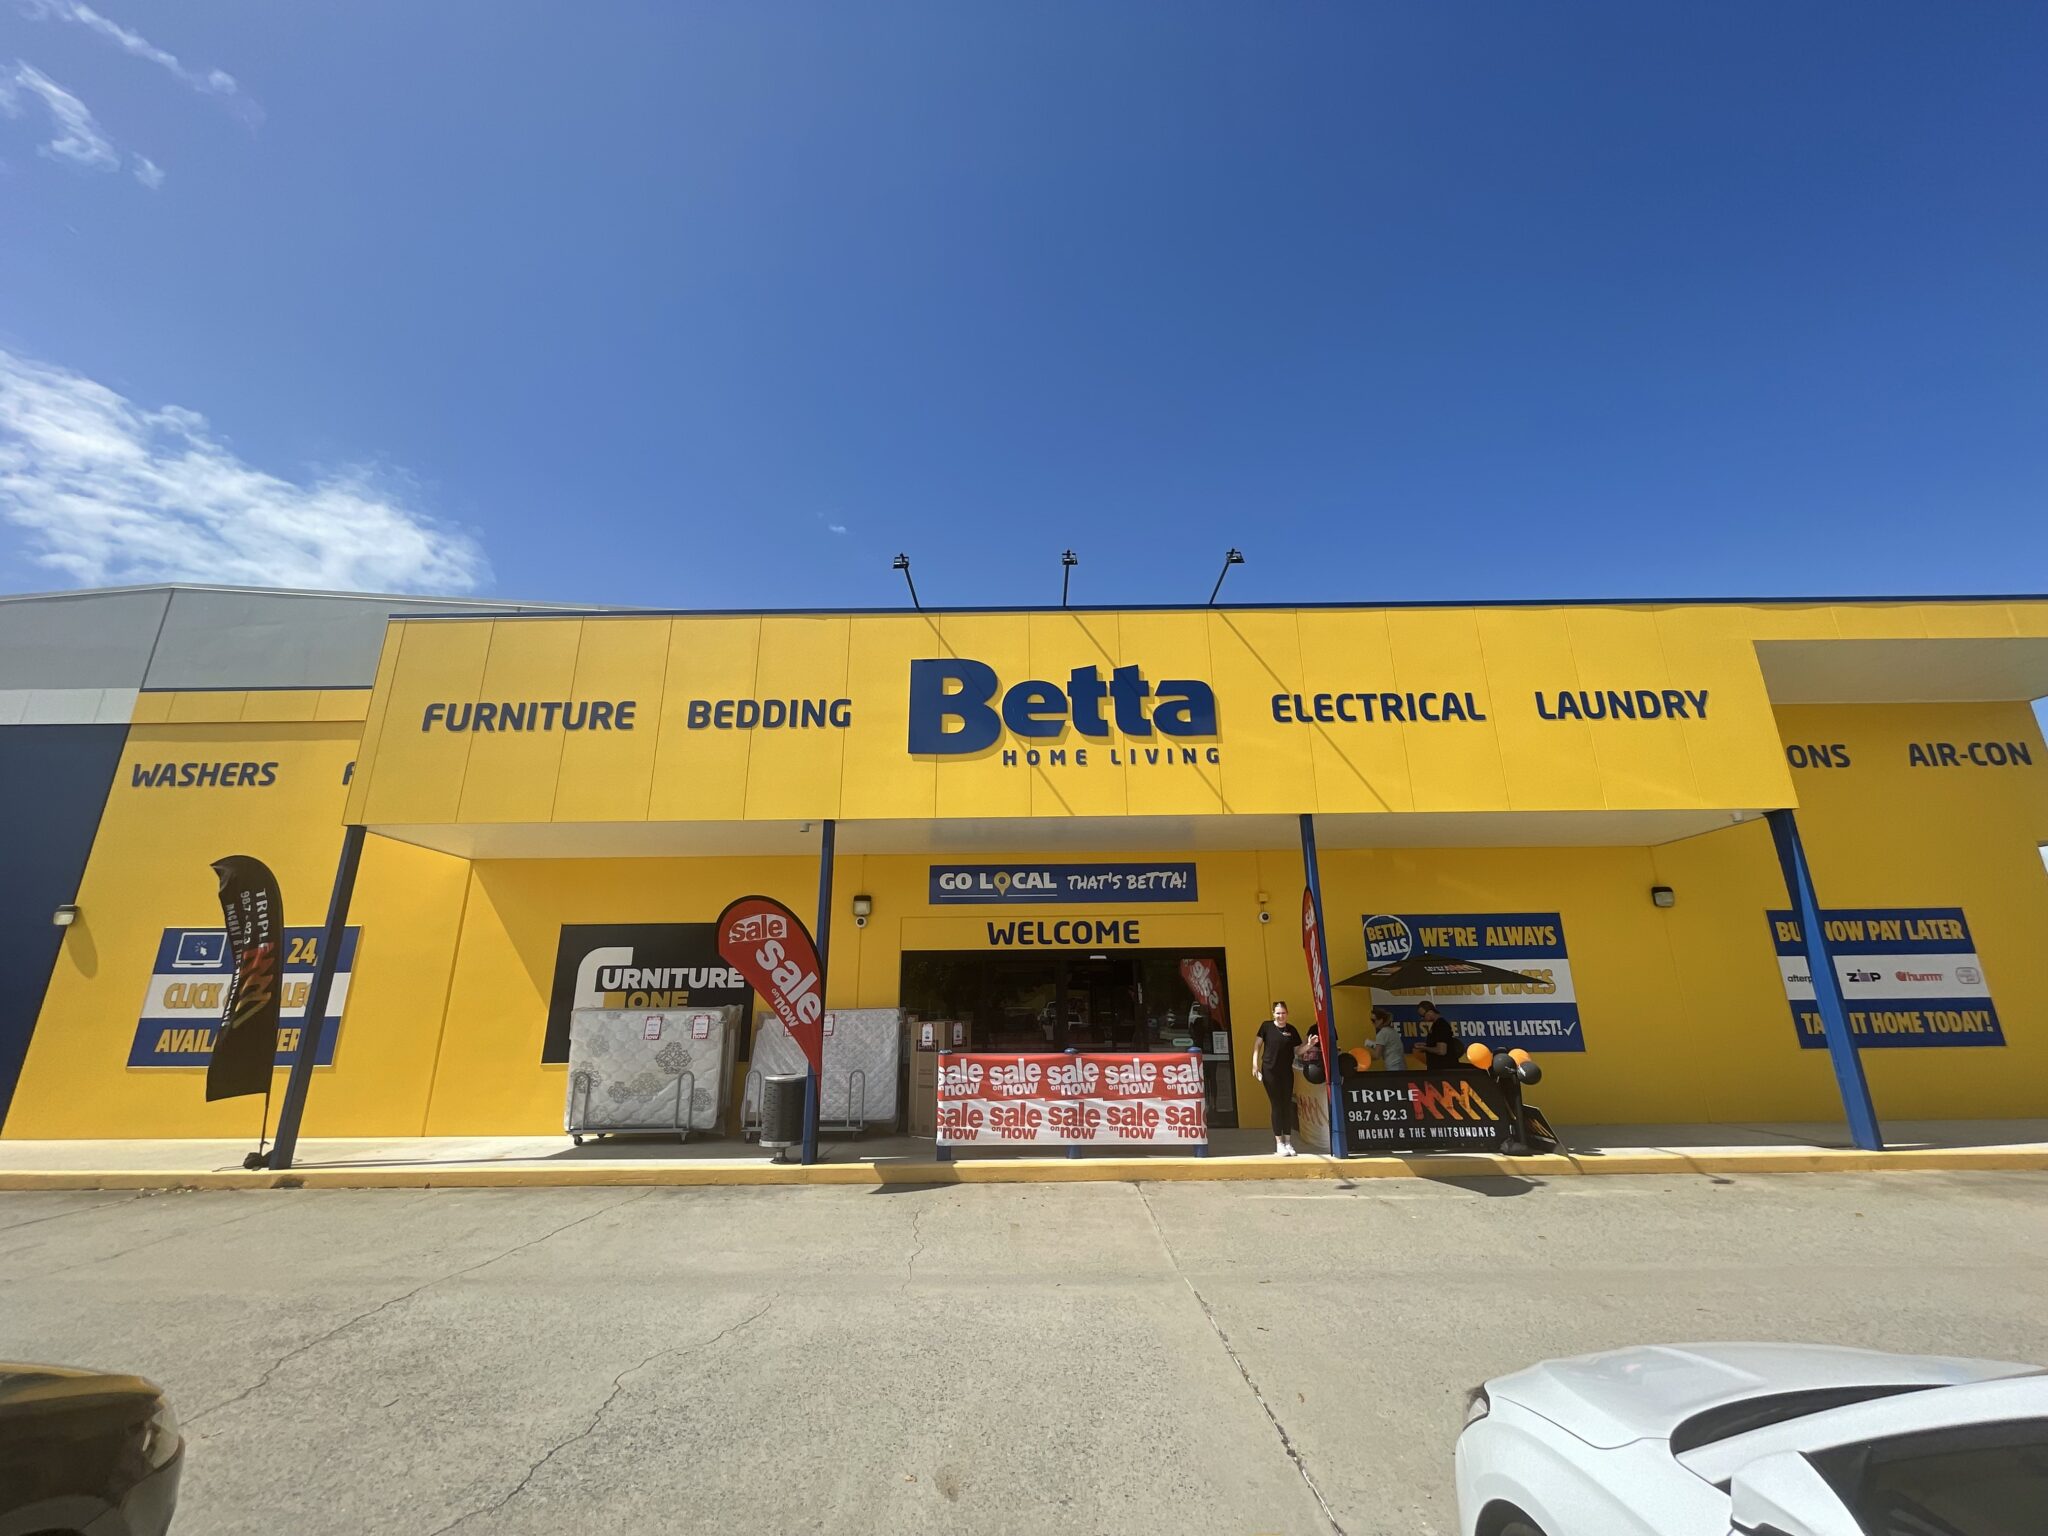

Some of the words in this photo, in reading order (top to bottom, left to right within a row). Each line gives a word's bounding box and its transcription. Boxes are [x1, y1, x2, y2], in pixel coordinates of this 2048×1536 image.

[422, 701, 636, 731] FURNITURE
[687, 699, 852, 729] BEDDING
[908, 658, 1218, 754] Betta
[1272, 693, 1486, 722] ELECTRICAL
[1535, 690, 1708, 719] LAUNDRY
[1003, 749, 1087, 766] HOME
[1111, 748, 1220, 765] LIVING
[1786, 744, 1851, 768] ONS
[1908, 742, 2032, 766] AIR-CON
[132, 762, 279, 787] WASHERS
[939, 872, 973, 890] GO
[979, 871, 1057, 896] LOCAL
[1067, 871, 1122, 890] THAT'S
[1126, 871, 1187, 890] BETTA!
[255, 888, 269, 949] TRIPLE
[730, 914, 784, 943] sale
[1775, 921, 1802, 942] BU
[1866, 920, 1902, 941] PAY
[1905, 919, 1965, 940] LATER
[987, 920, 1140, 945] WELCOME
[1366, 922, 1405, 942] BETTA
[1419, 927, 1479, 947] WE'RE
[1486, 926, 1557, 946] ALWAYS
[1370, 937, 1409, 958] DEALS
[755, 939, 821, 1025] sale
[1787, 973, 1814, 983] afterp
[163, 983, 223, 1009] CLICK
[774, 997, 799, 1029] now
[1800, 1012, 1826, 1035] TA
[1849, 1012, 1867, 1034] IT
[1871, 1011, 1925, 1034] HOME
[1924, 1010, 1994, 1033] TODAY!
[155, 1029, 216, 1053] AVAIL
[1403, 1022, 1417, 1038] IN
[1461, 1020, 1486, 1037] FOR
[1487, 1020, 1511, 1036] THE
[1514, 1020, 1562, 1036] LATEST!
[938, 1058, 984, 1085] sale
[989, 1058, 1042, 1085] sale
[1046, 1057, 1100, 1085] sale
[1104, 1057, 1157, 1085] sale
[1162, 1057, 1203, 1085] sal
[944, 1082, 981, 1097] now
[1002, 1082, 1038, 1096] now
[1060, 1082, 1096, 1096] now
[1118, 1081, 1154, 1096] now
[1348, 1089, 1419, 1103] TRIPLE
[937, 1102, 984, 1128] sale
[989, 1102, 1042, 1128] sale
[1048, 1102, 1101, 1128] sale
[1106, 1101, 1160, 1128] sale
[1348, 1110, 1371, 1121] 98.7
[1382, 1109, 1408, 1121] 92.3
[942, 1127, 979, 1140] now
[1001, 1127, 1038, 1140] now
[1060, 1126, 1097, 1140] now
[1118, 1126, 1155, 1140] now
[1358, 1127, 1394, 1140] MACKAY
[1399, 1127, 1405, 1138] &
[1409, 1127, 1426, 1138] THE
[1430, 1126, 1496, 1138] WHITSUNDAYS
